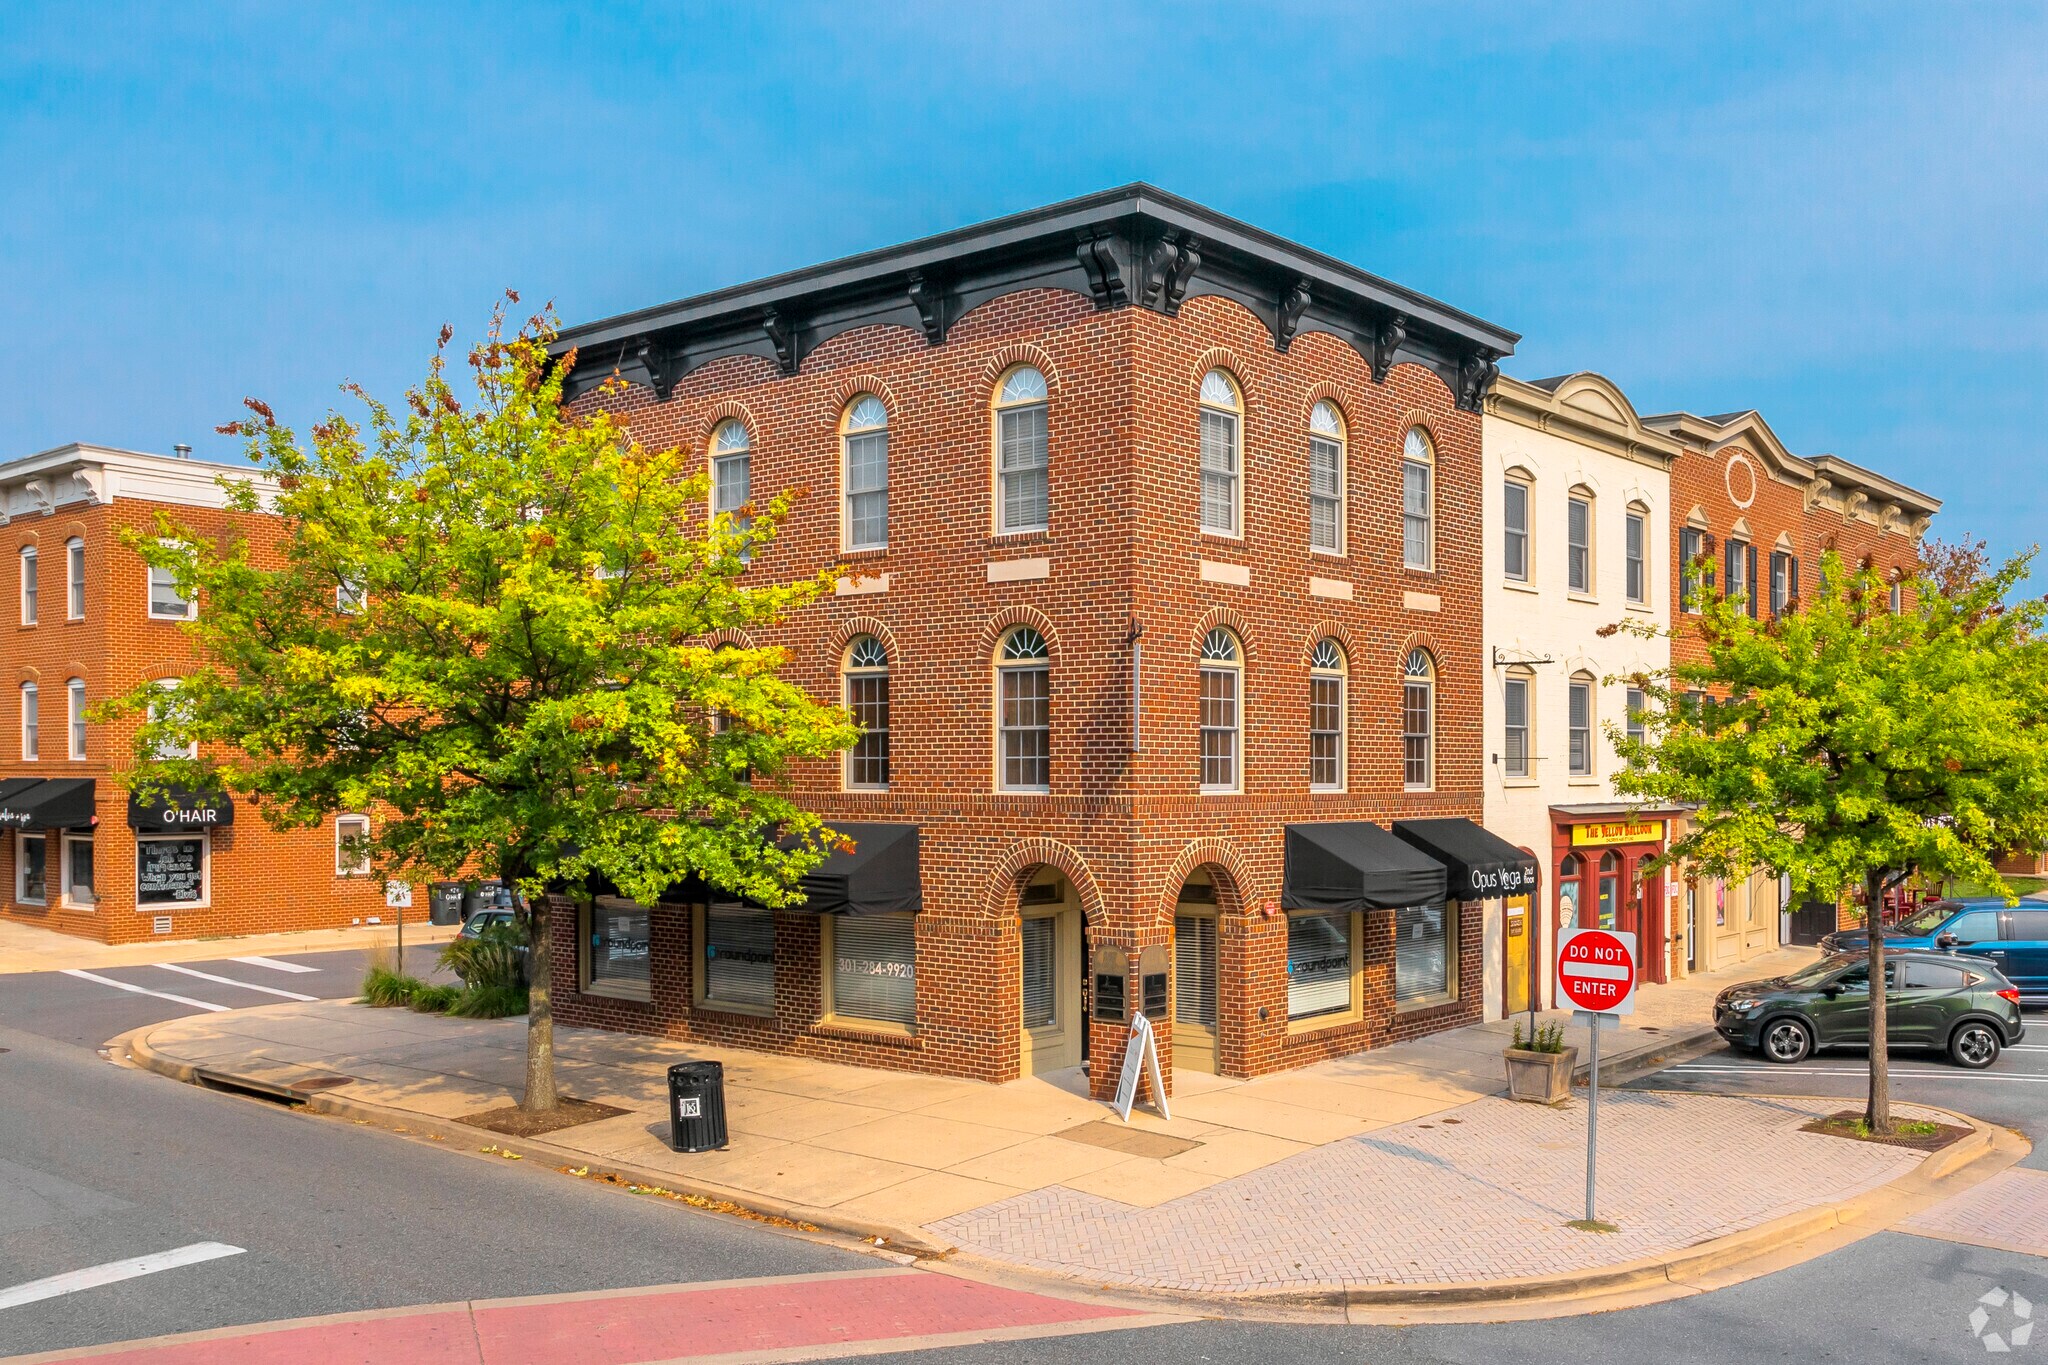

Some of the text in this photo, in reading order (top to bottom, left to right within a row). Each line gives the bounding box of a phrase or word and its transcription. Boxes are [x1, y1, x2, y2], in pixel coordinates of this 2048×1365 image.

[163, 809, 217, 823] O'HAIR
[1471, 869, 1498, 893] Opus
[1569, 944, 1623, 962] DO NOT
[838, 957, 914, 979] 301-284-9920
[1573, 980, 1617, 997] ENTER
